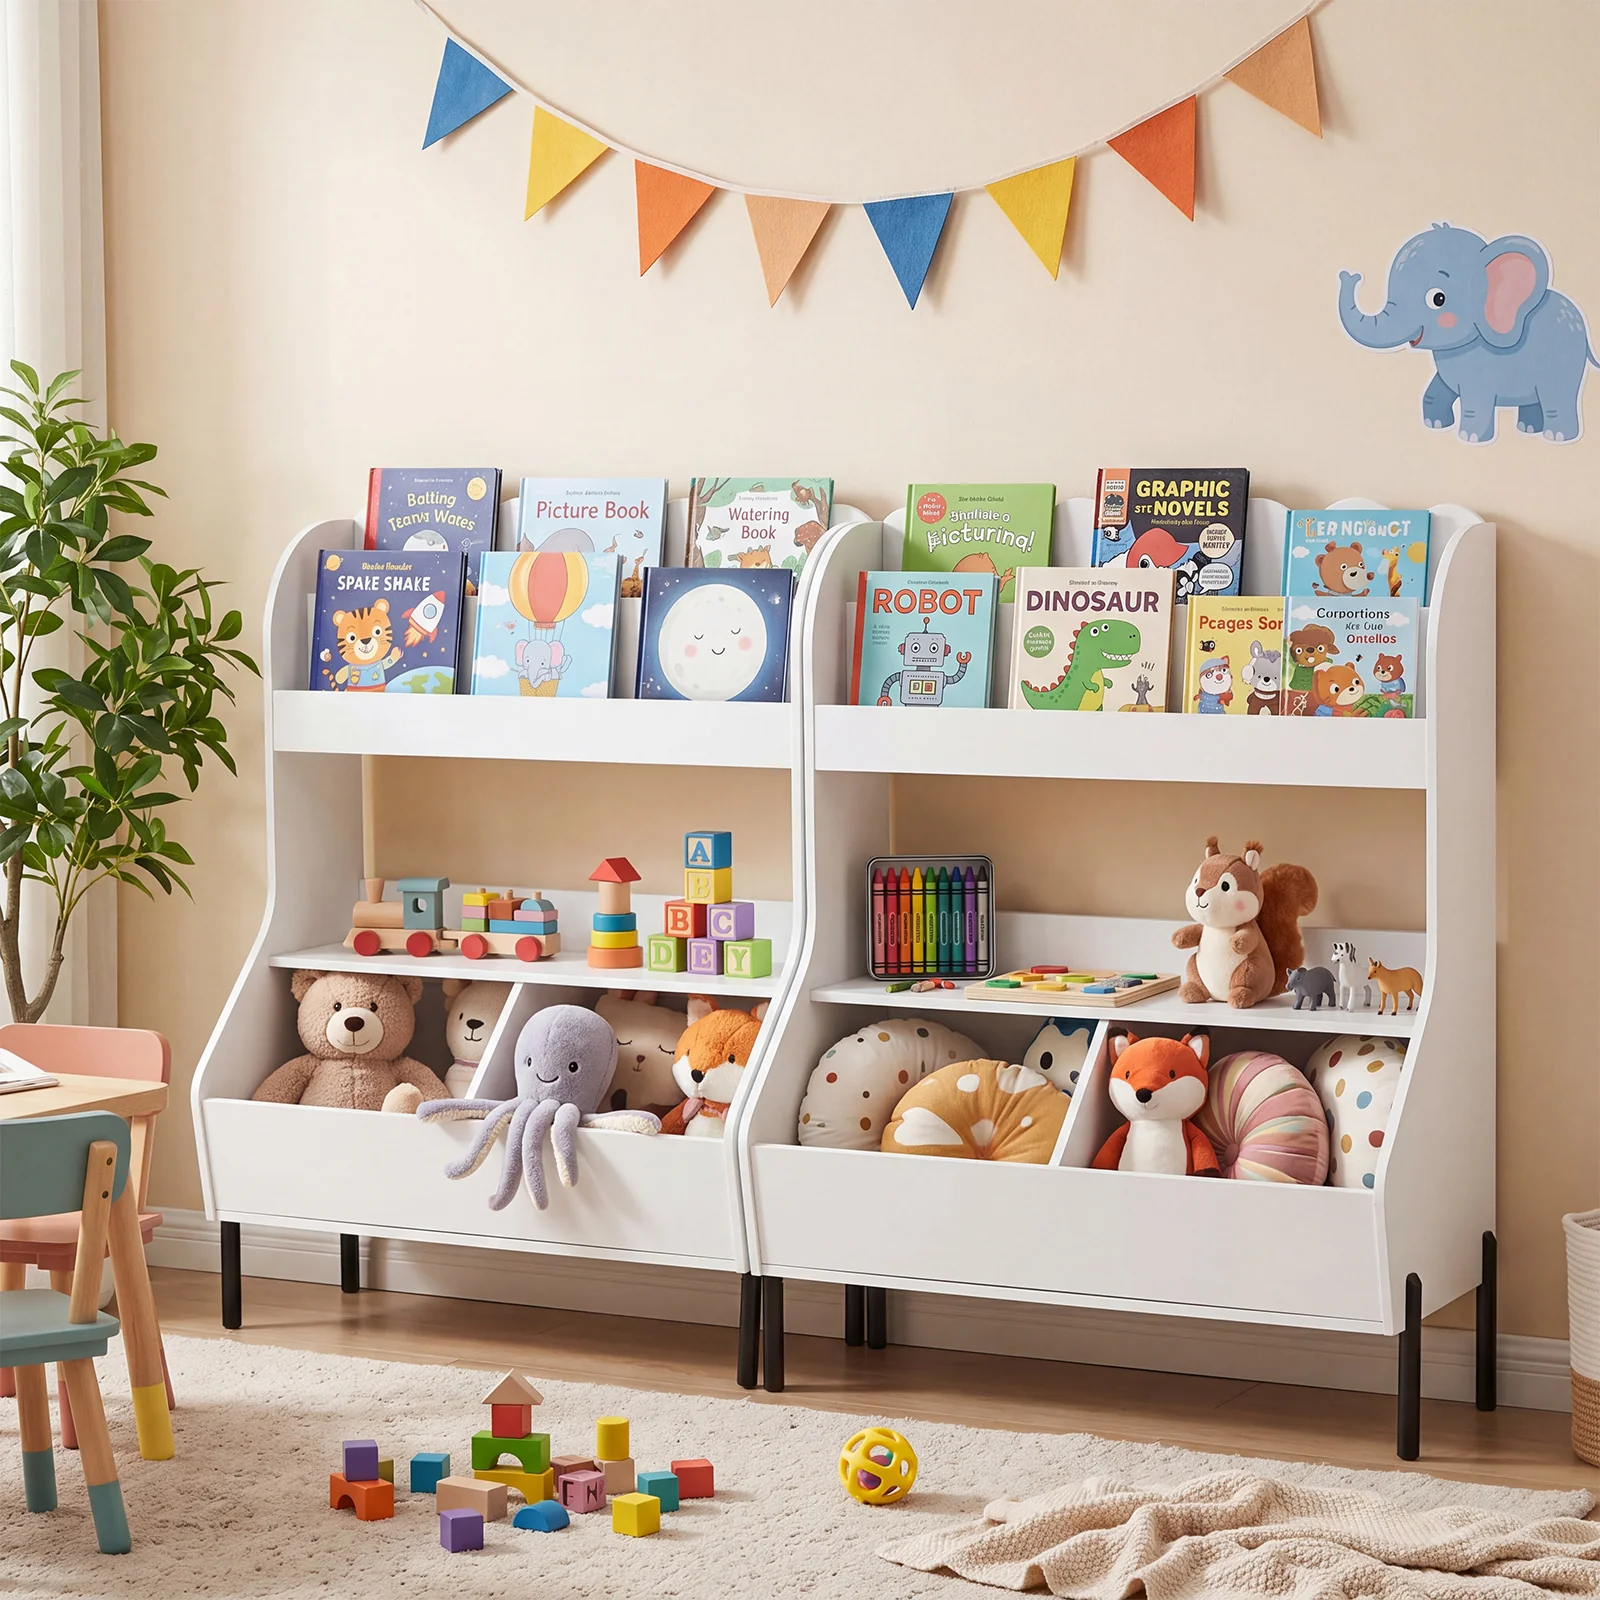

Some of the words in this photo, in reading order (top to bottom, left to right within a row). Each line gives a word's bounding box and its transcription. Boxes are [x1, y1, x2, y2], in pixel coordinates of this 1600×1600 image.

[1136, 480, 1231, 498] GRAPHIC
[536, 500, 598, 519] Picture
[605, 500, 650, 519] Book
[728, 507, 790, 524] Watering
[1153, 500, 1229, 517] NOVELS
[741, 525, 777, 540] Book
[383, 576, 431, 592] SHAKE
[872, 588, 983, 615] ROBOT
[1026, 590, 1160, 613] DINOSAUR
[1316, 607, 1390, 619] Corportions
[1199, 615, 1253, 633] Pcages
[1346, 633, 1397, 644] Ontellos
[689, 840, 711, 863] A
[690, 875, 711, 899] B
[670, 908, 689, 932] B
[712, 911, 732, 935] C
[652, 942, 672, 965] D
[693, 945, 712, 969] E
[730, 948, 748, 972] Y
